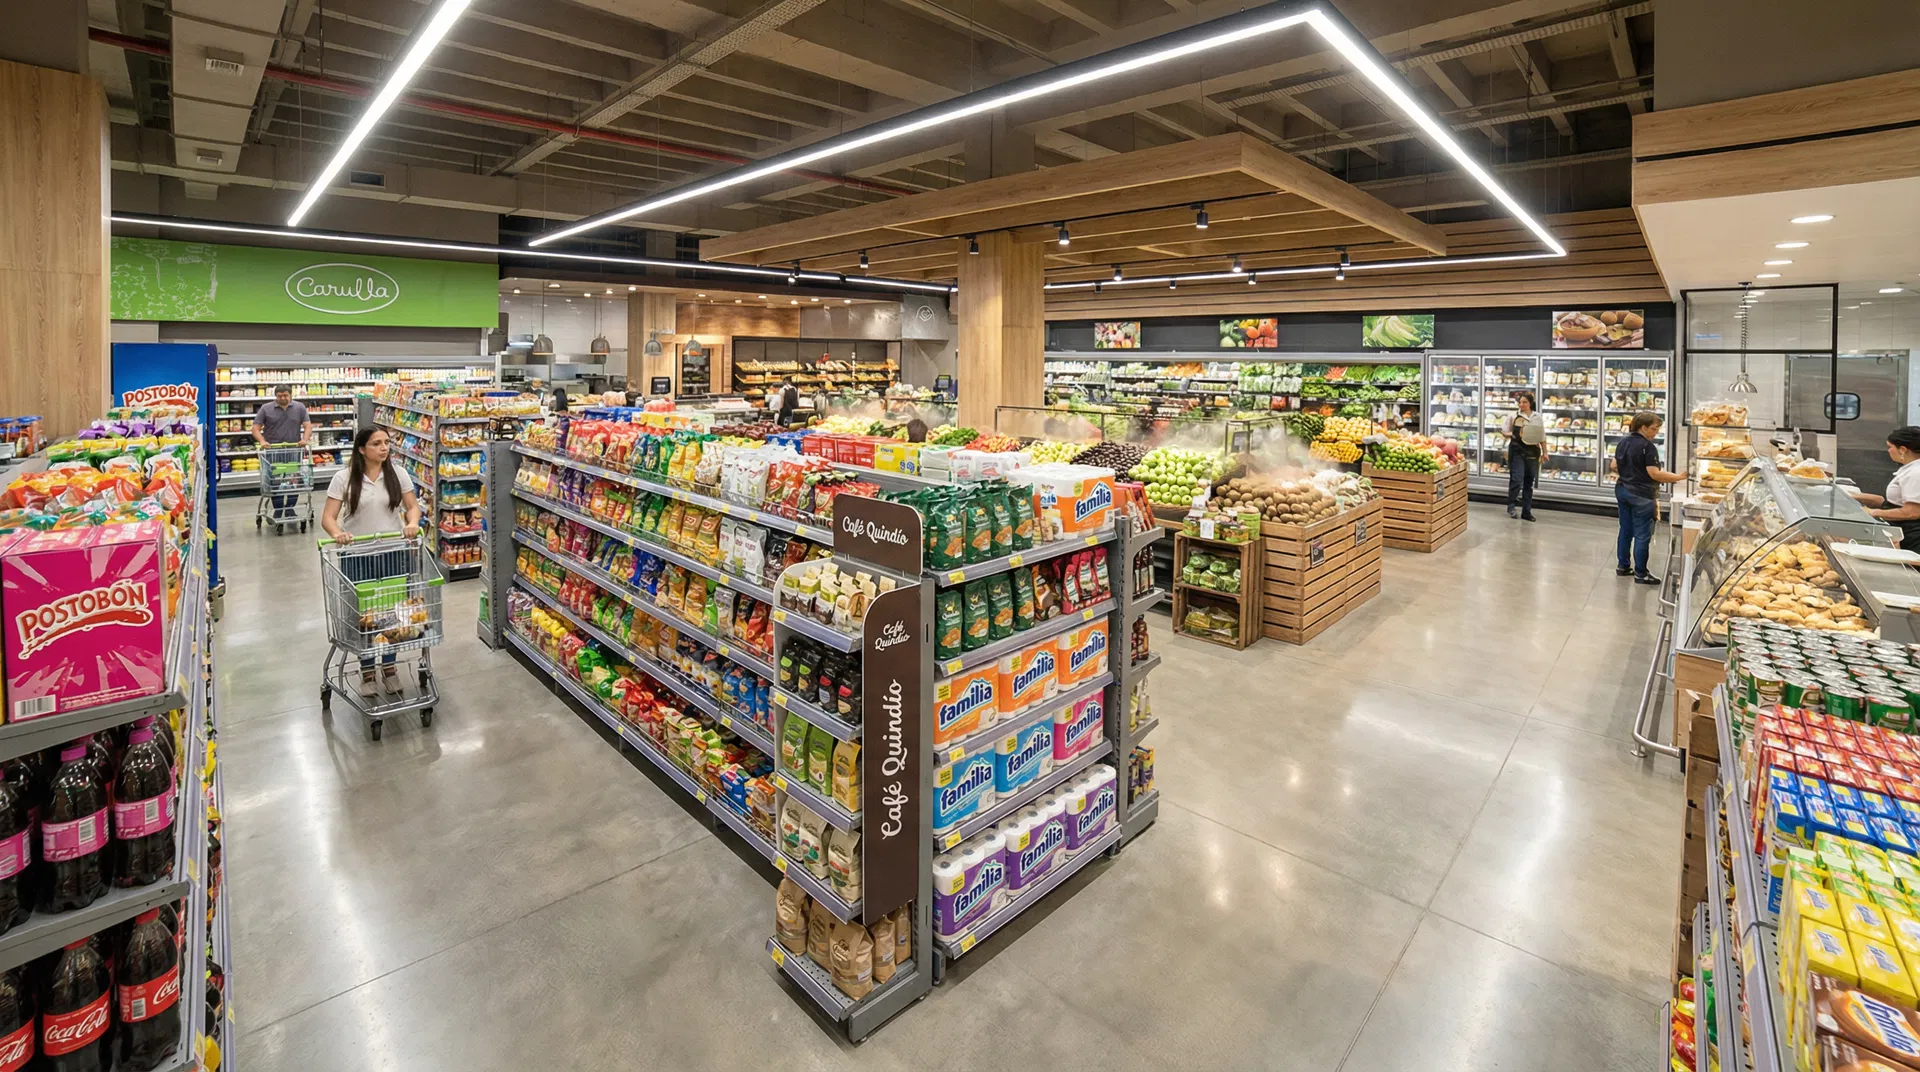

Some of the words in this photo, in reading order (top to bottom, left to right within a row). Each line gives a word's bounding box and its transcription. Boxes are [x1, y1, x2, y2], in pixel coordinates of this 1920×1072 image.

[297, 277, 389, 301] Carulla
[1076, 484, 1112, 518] familia
[842, 516, 865, 538] Café
[866, 521, 909, 545] Quindío
[1071, 633, 1106, 668] familia
[1013, 655, 1054, 694] familia
[940, 684, 993, 725] familia
[1066, 706, 1101, 743] familia
[882, 678, 908, 776] Quindío
[1008, 733, 1051, 775] familia
[941, 765, 992, 810] familia
[881, 781, 909, 840] Café
[1079, 791, 1114, 833] familia
[1021, 826, 1063, 872] familia
[954, 866, 1002, 916] familia
[45, 1000, 108, 1044] Coca-Cola
